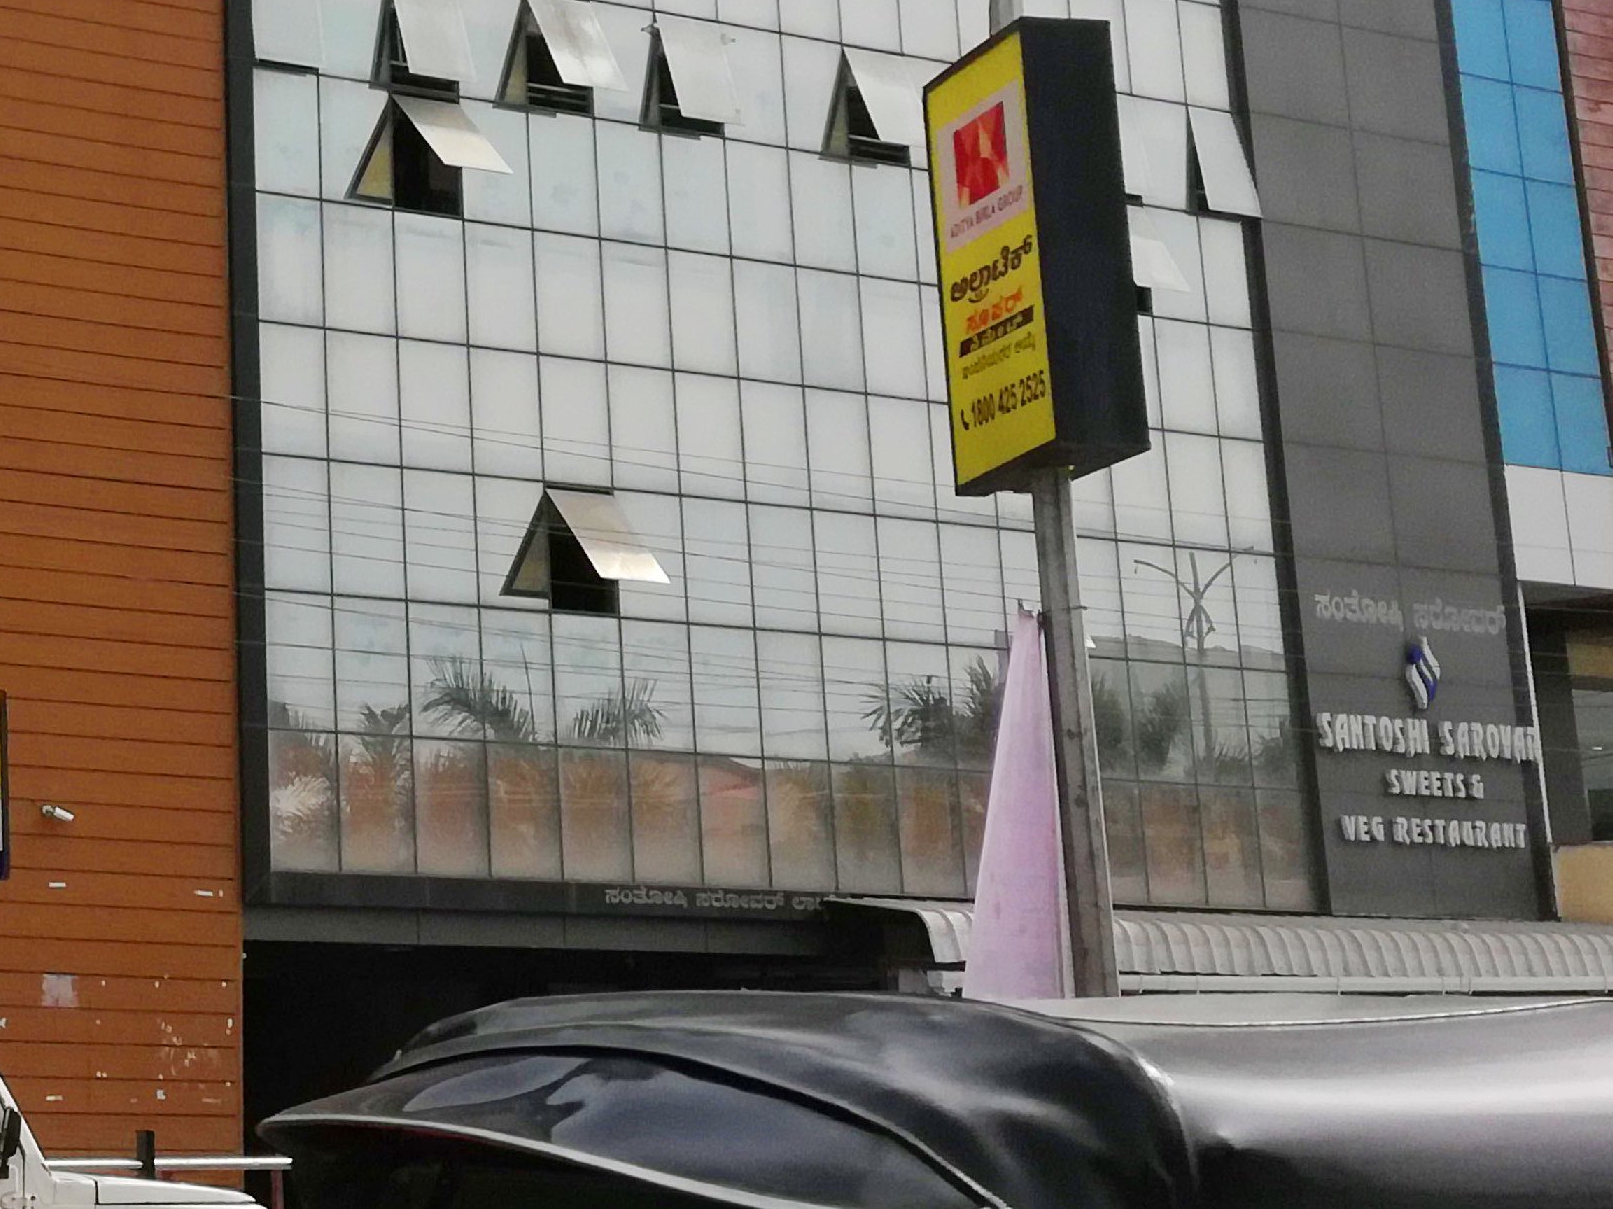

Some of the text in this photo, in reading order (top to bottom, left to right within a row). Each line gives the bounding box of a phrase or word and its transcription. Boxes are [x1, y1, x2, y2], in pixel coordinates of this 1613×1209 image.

[971, 369, 1046, 427] 1800 425 2525
[1315, 712, 1541, 764] SANTOSHI SAROVAR
[1386, 769, 1484, 799] SWEETS &
[1341, 814, 1526, 849] VEG RESTAURANT
